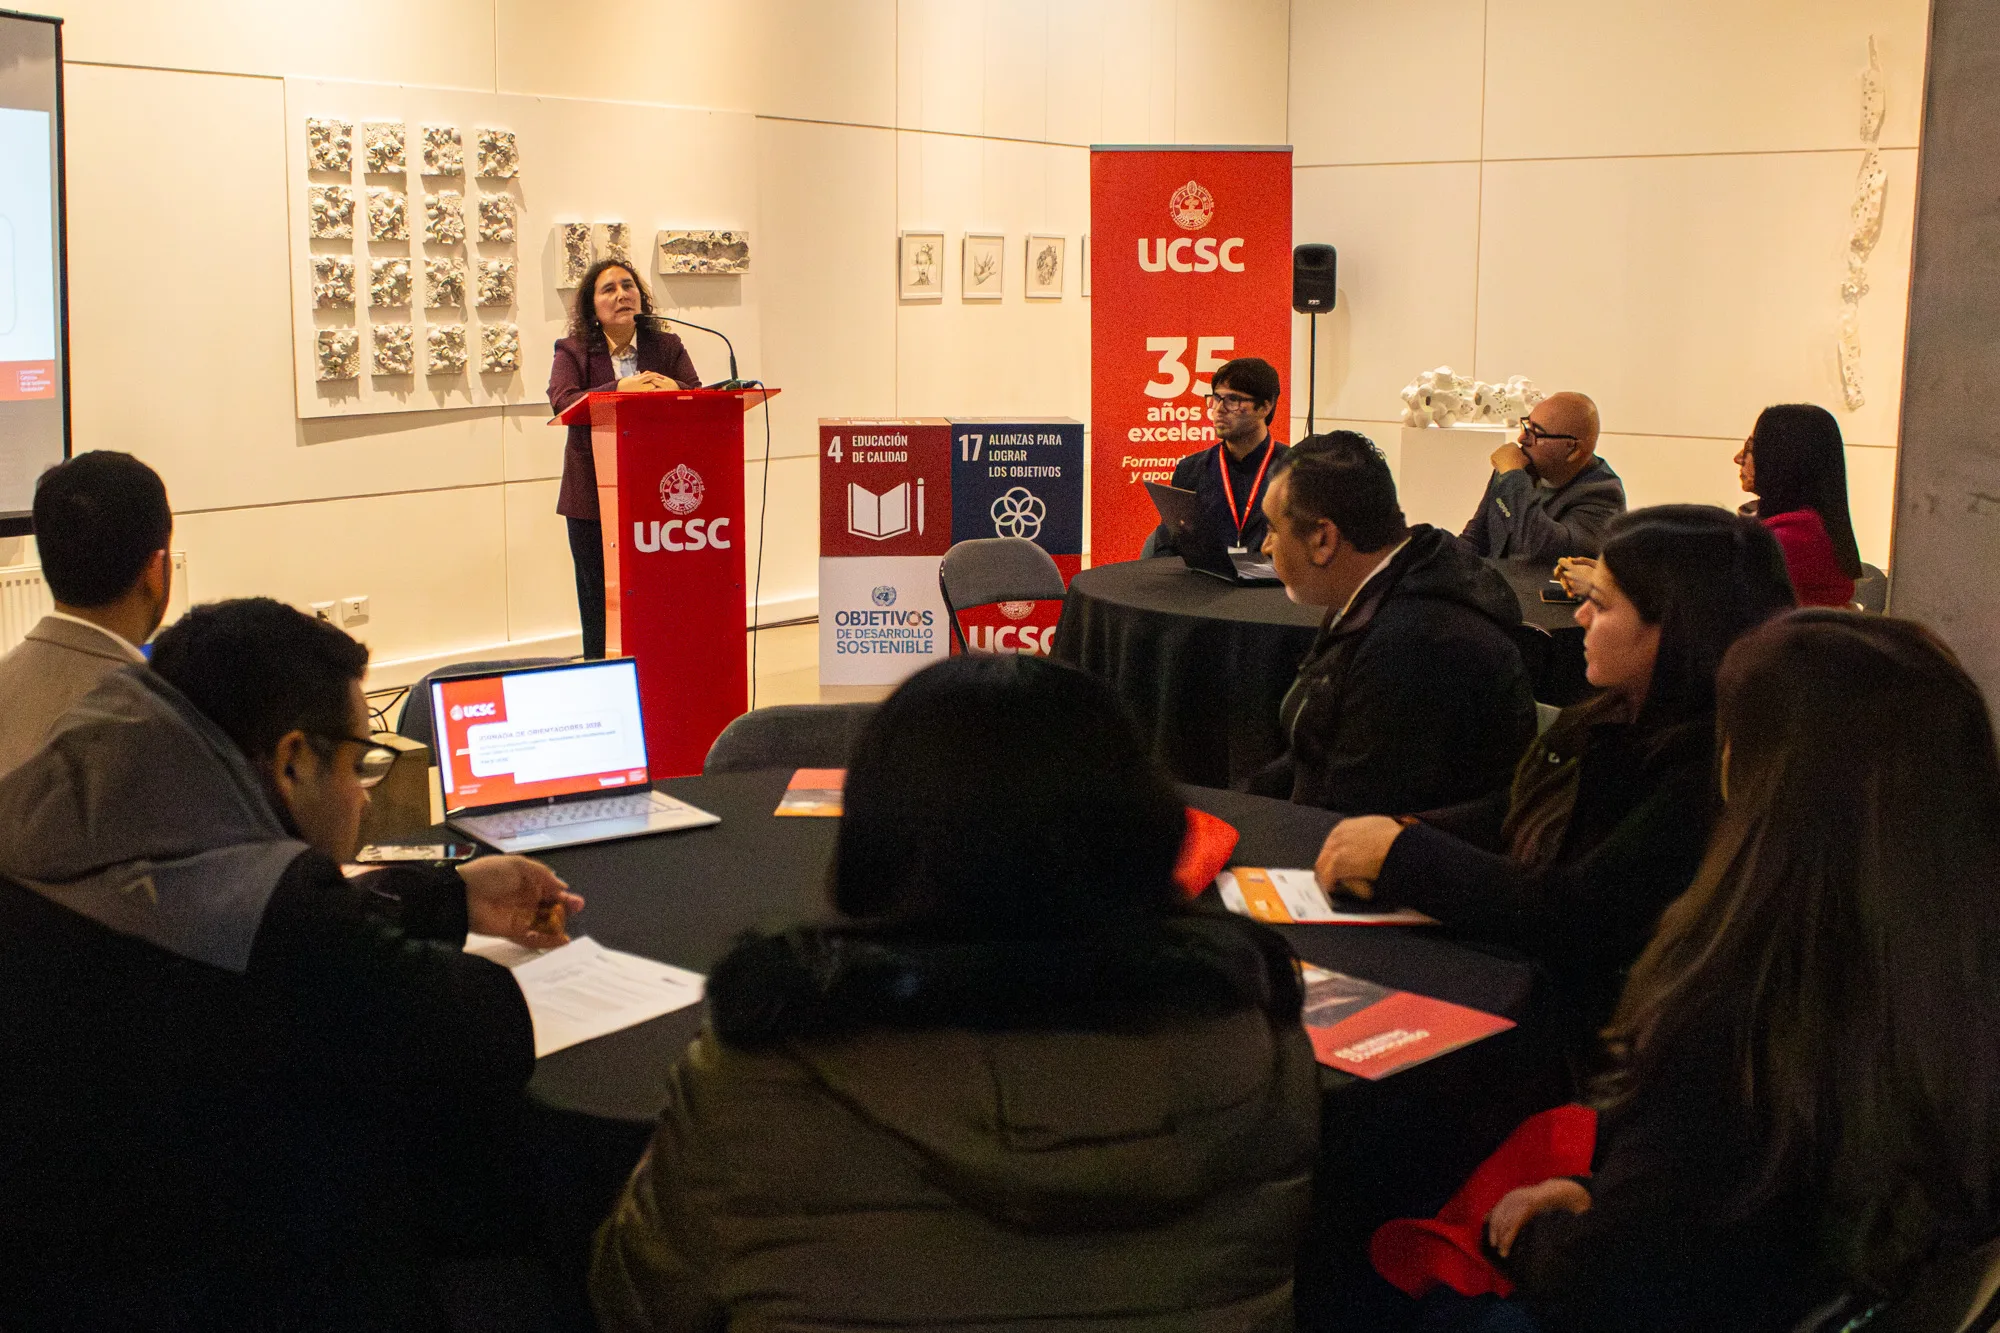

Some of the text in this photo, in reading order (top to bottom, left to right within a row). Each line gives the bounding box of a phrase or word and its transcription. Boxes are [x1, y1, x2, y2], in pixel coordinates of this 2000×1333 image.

[1137, 238, 1245, 273] UCSC
[1144, 337, 1235, 399] 35
[1147, 402, 1201, 422] años
[852, 432, 908, 447] EDUCACIÓN
[989, 434, 1062, 446] ALIANZAS PARA
[827, 436, 843, 463] 4
[958, 434, 983, 462] 17
[852, 450, 908, 463] DE CALIDAD
[989, 450, 1027, 462] LOGRAR
[989, 466, 1061, 478] LOS OBJETIVOS
[1130, 472, 1140, 484] y
[634, 518, 731, 553] UCSC
[835, 611, 933, 627] OBJETIVOS
[837, 628, 933, 639] DE DESARROLLO
[836, 641, 933, 654] SOSTENIBLE
[463, 702, 496, 718] UCSC
[528, 723, 584, 736] ORIENTADORES
